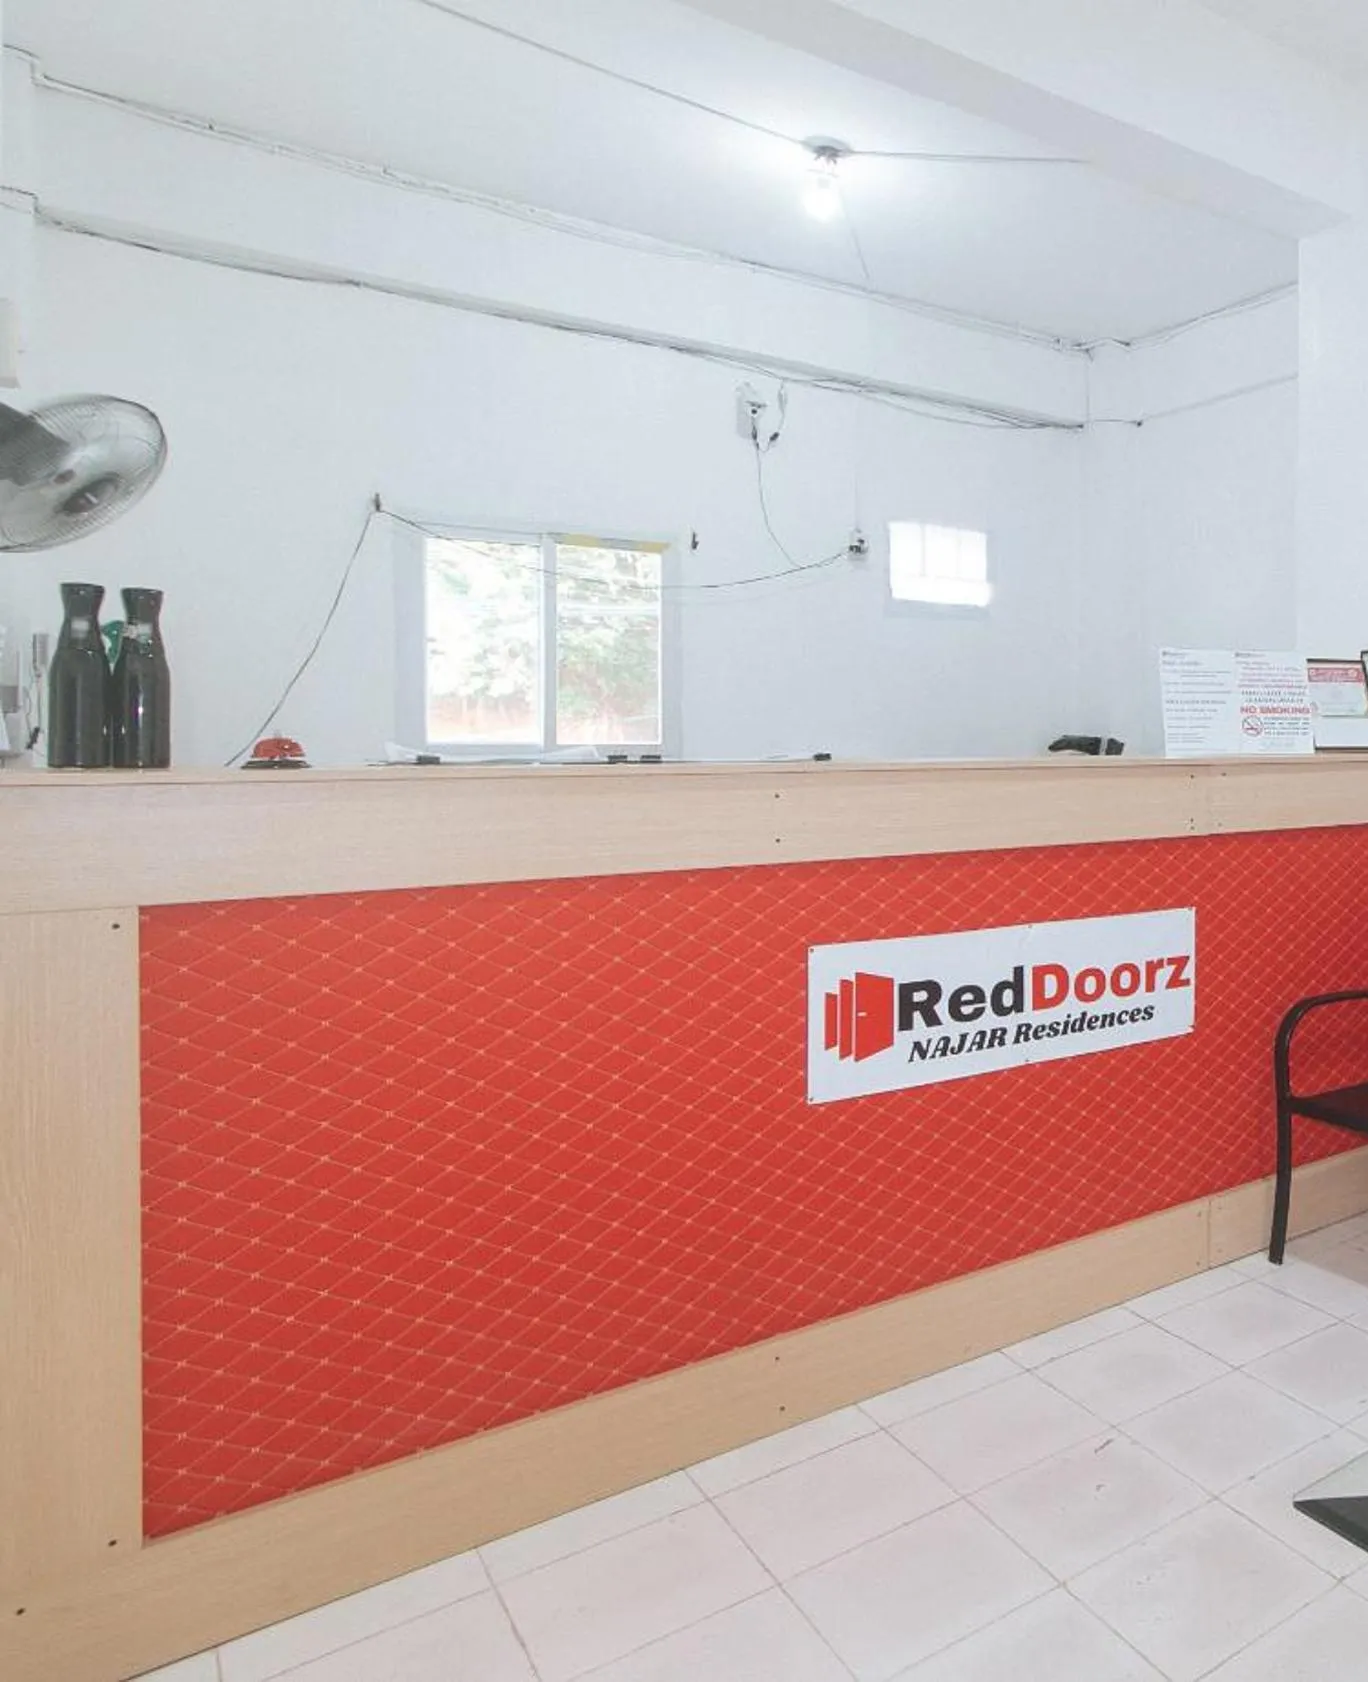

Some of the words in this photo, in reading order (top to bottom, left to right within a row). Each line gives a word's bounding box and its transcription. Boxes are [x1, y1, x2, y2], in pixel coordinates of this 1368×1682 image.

[1240, 705, 1257, 714] NO
[1260, 705, 1311, 715] SMOKING
[898, 955, 1191, 1032] RedDoorz
[907, 1026, 1009, 1063] NAJAR
[1012, 1004, 1155, 1045] Residences
